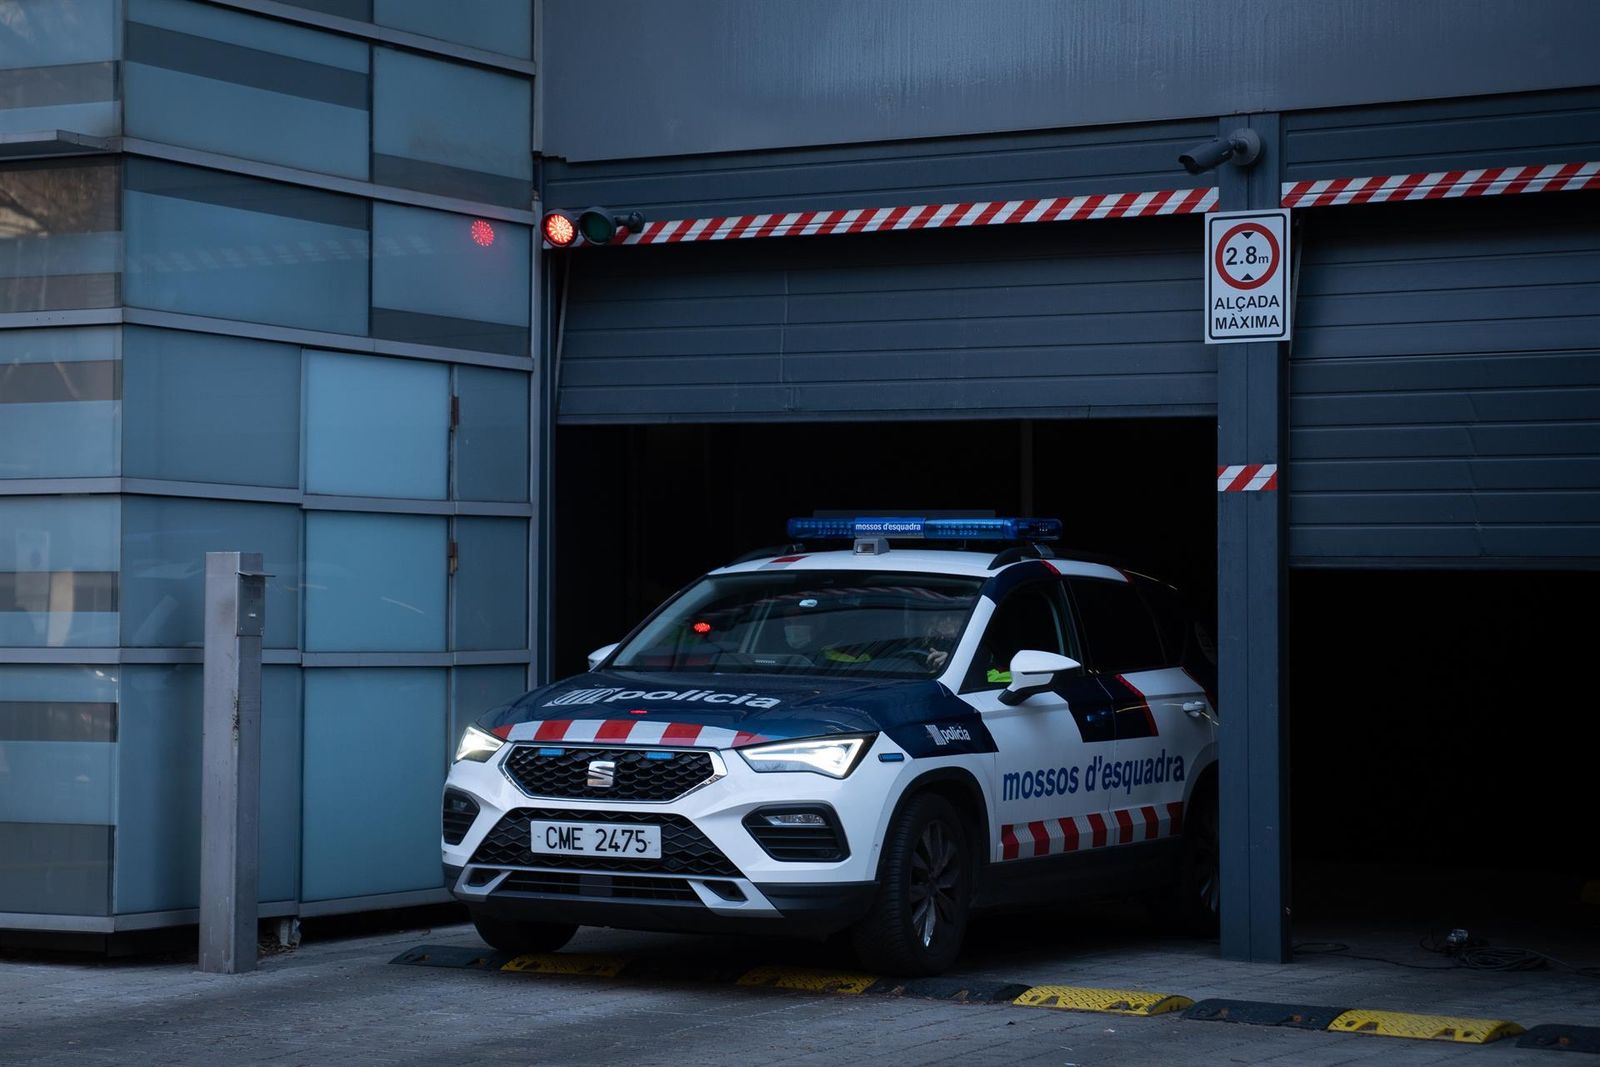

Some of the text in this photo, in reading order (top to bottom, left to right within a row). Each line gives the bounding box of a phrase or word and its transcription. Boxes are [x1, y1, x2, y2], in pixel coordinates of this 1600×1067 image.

[1214, 295, 1280, 312] ALÇADA
[1215, 313, 1280, 330] MÀXIMA
[855, 522, 921, 533] mossos d'esquadra
[602, 689, 781, 709] policia
[940, 724, 971, 744] policia
[1003, 749, 1185, 801] mossos d'esquadra
[546, 826, 647, 853] CME 2475
